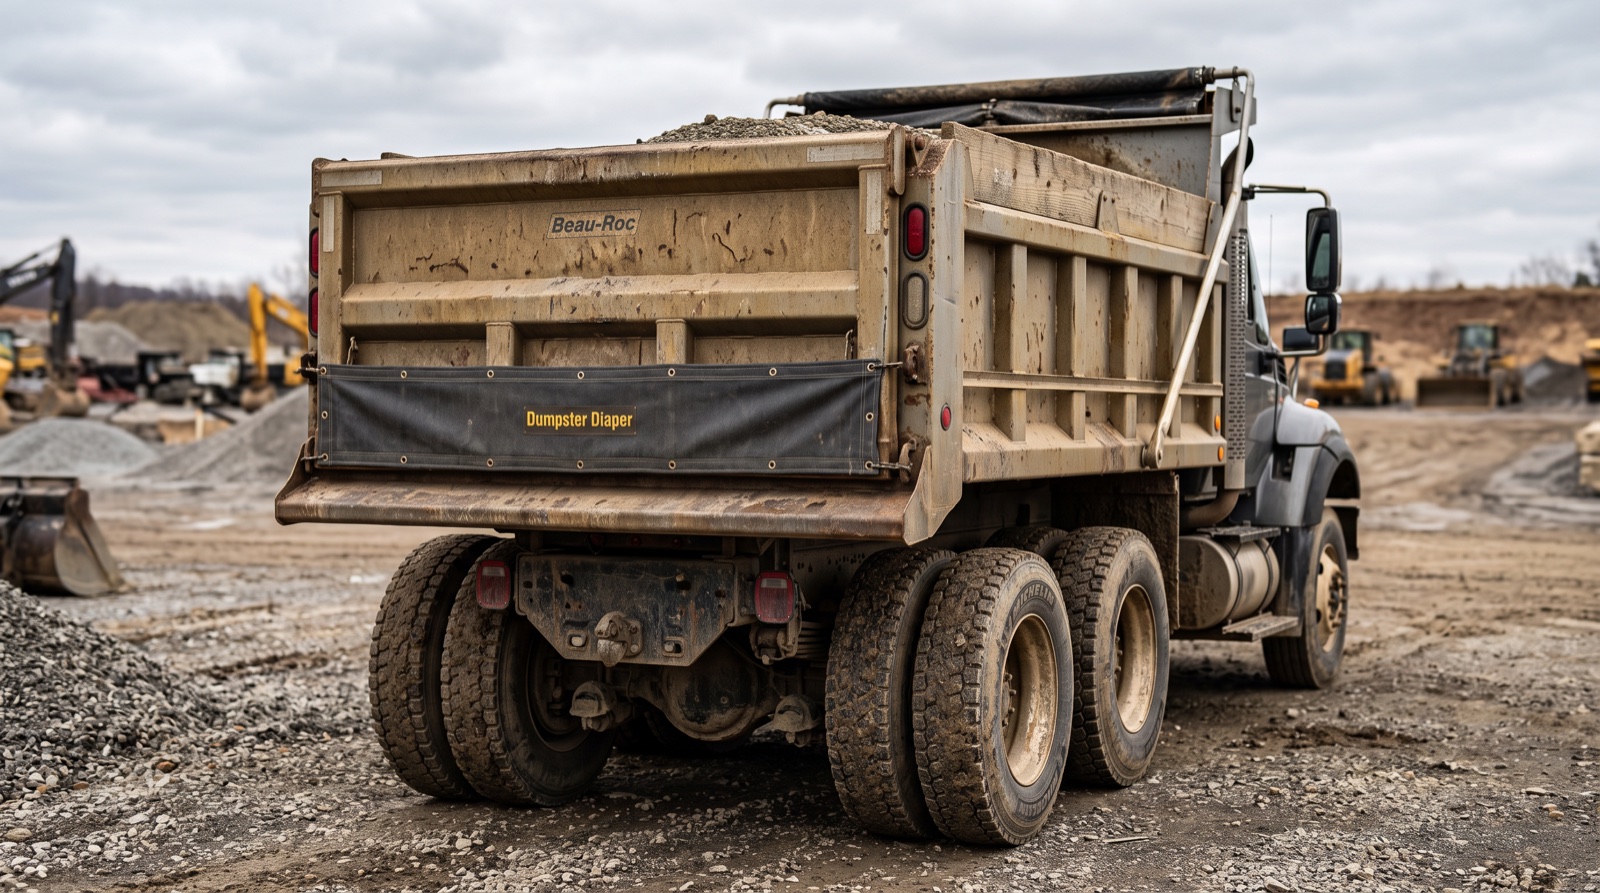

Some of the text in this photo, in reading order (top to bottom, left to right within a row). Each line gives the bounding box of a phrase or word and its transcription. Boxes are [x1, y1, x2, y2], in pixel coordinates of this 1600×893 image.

[552, 215, 635, 233] Beau-Roc
[527, 411, 633, 431] Dumpster Diaper
